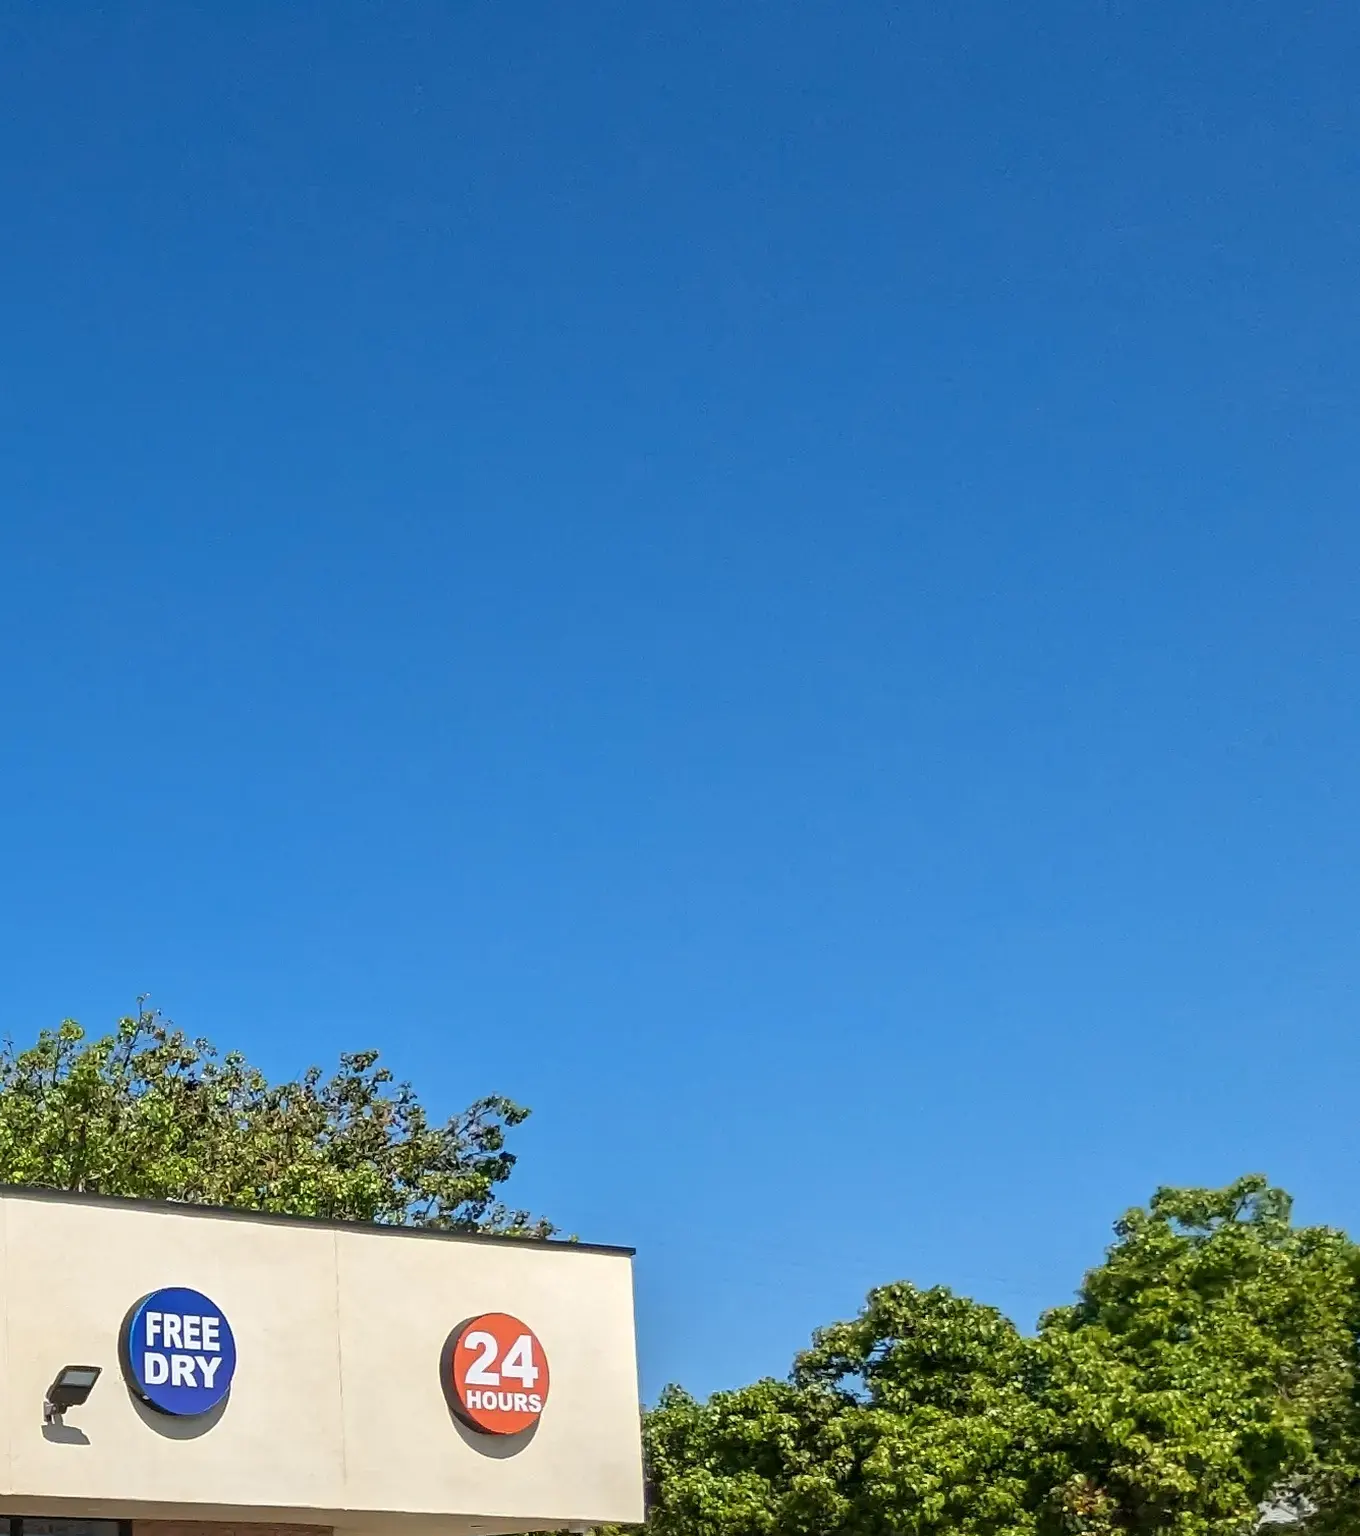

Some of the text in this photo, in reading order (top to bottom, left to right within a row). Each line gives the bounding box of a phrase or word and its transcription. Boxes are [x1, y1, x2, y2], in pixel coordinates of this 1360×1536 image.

[145, 1311, 221, 1352] FREE
[143, 1352, 223, 1389] DRY
[463, 1331, 540, 1388] 24
[466, 1389, 543, 1413] HOURS
